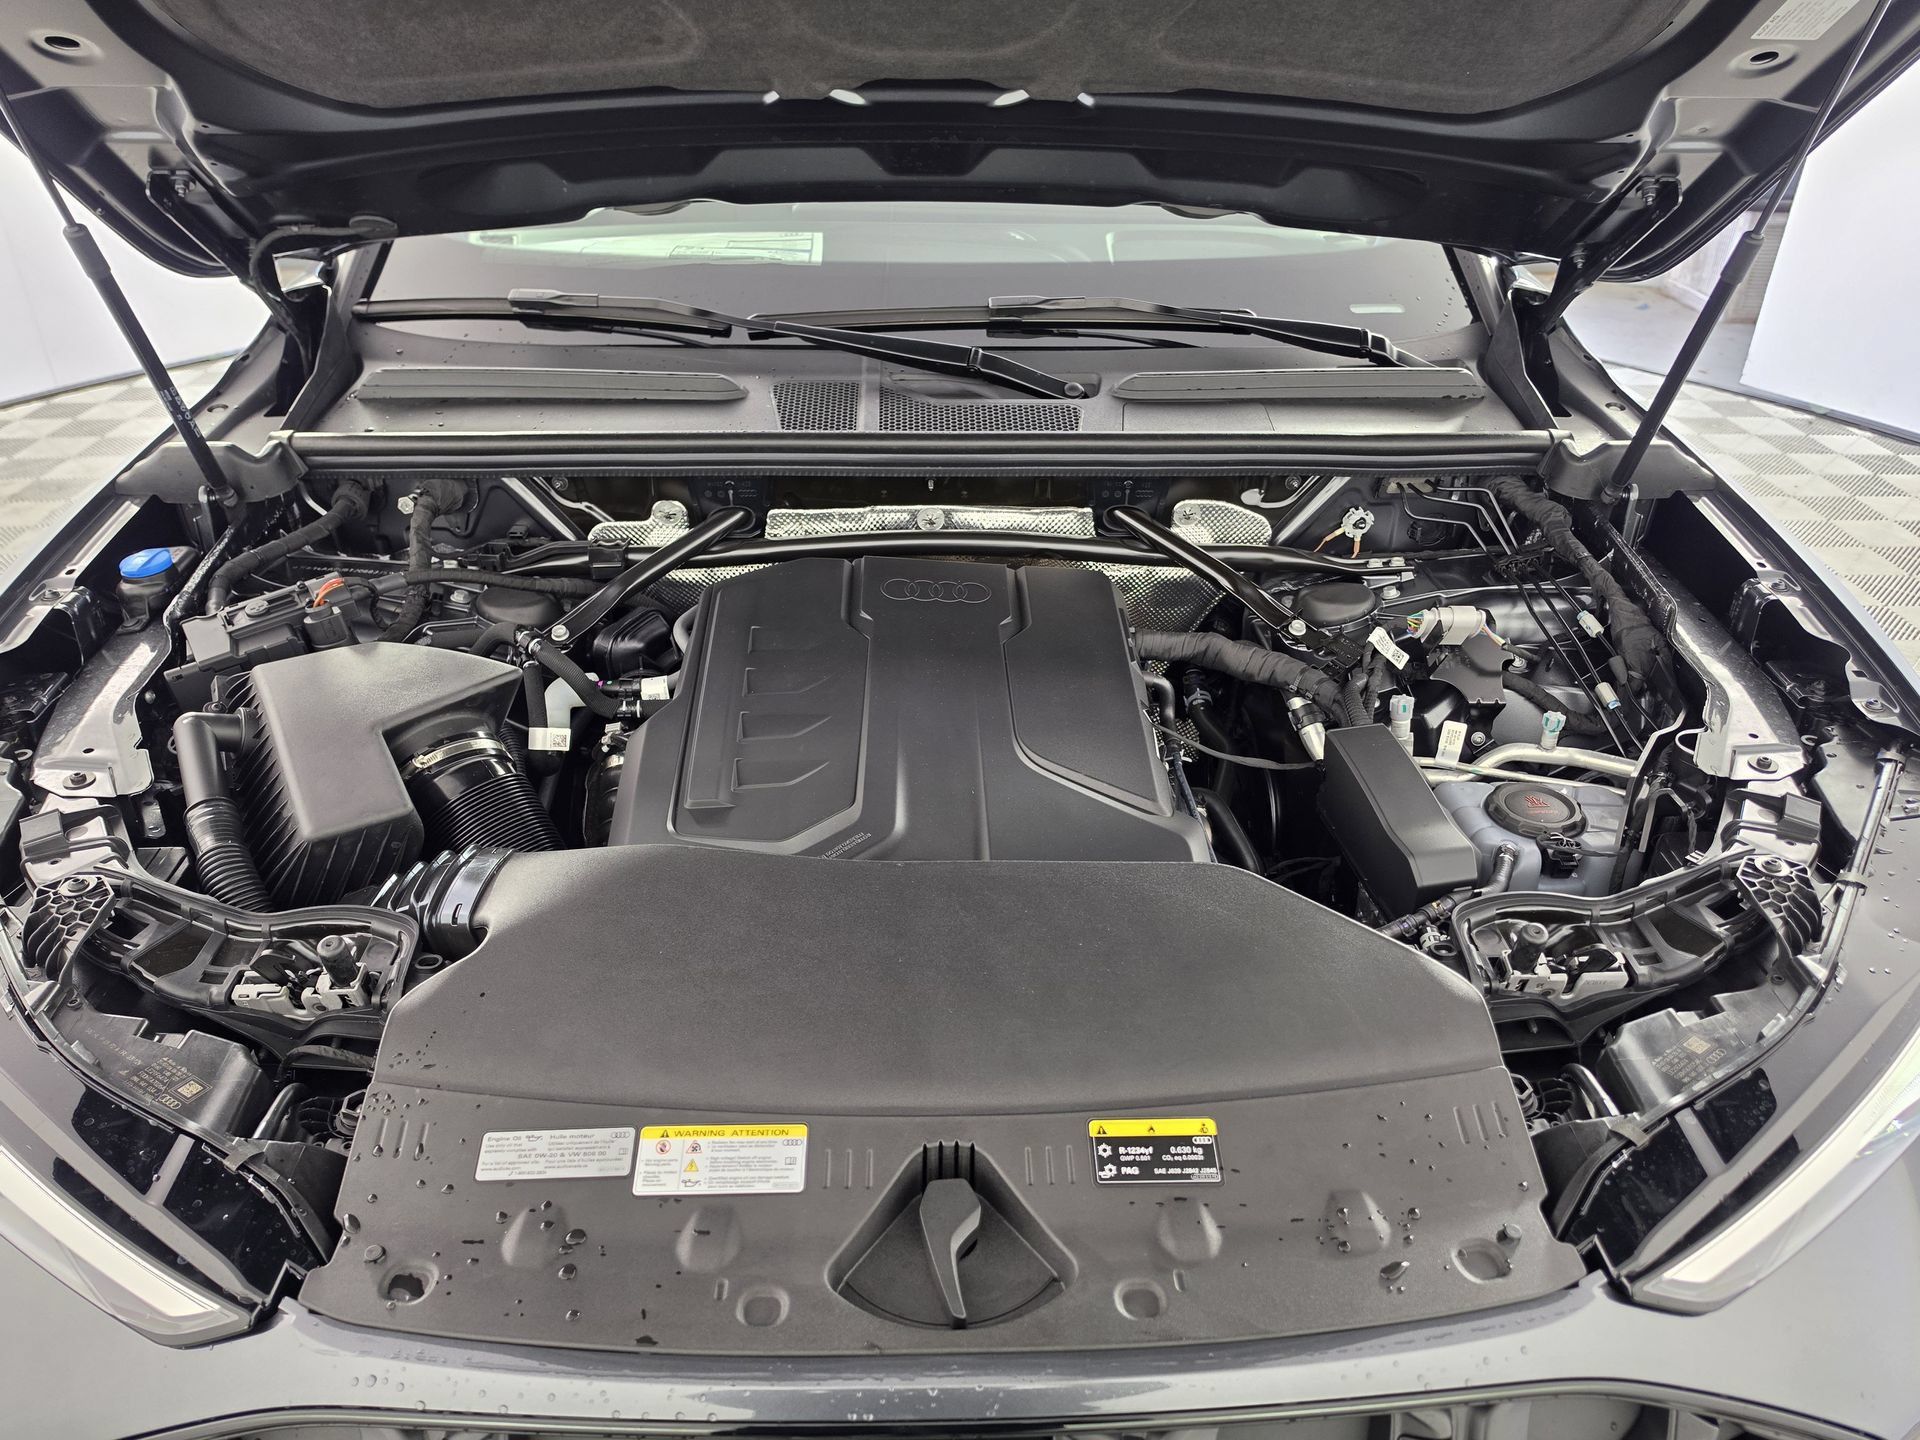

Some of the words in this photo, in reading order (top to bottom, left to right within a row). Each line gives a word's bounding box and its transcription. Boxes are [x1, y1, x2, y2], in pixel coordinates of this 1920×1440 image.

[1170, 1146, 1191, 1154] 0.630
[1192, 1146, 1203, 1155] kg
[1121, 1167, 1140, 1175] PAG
